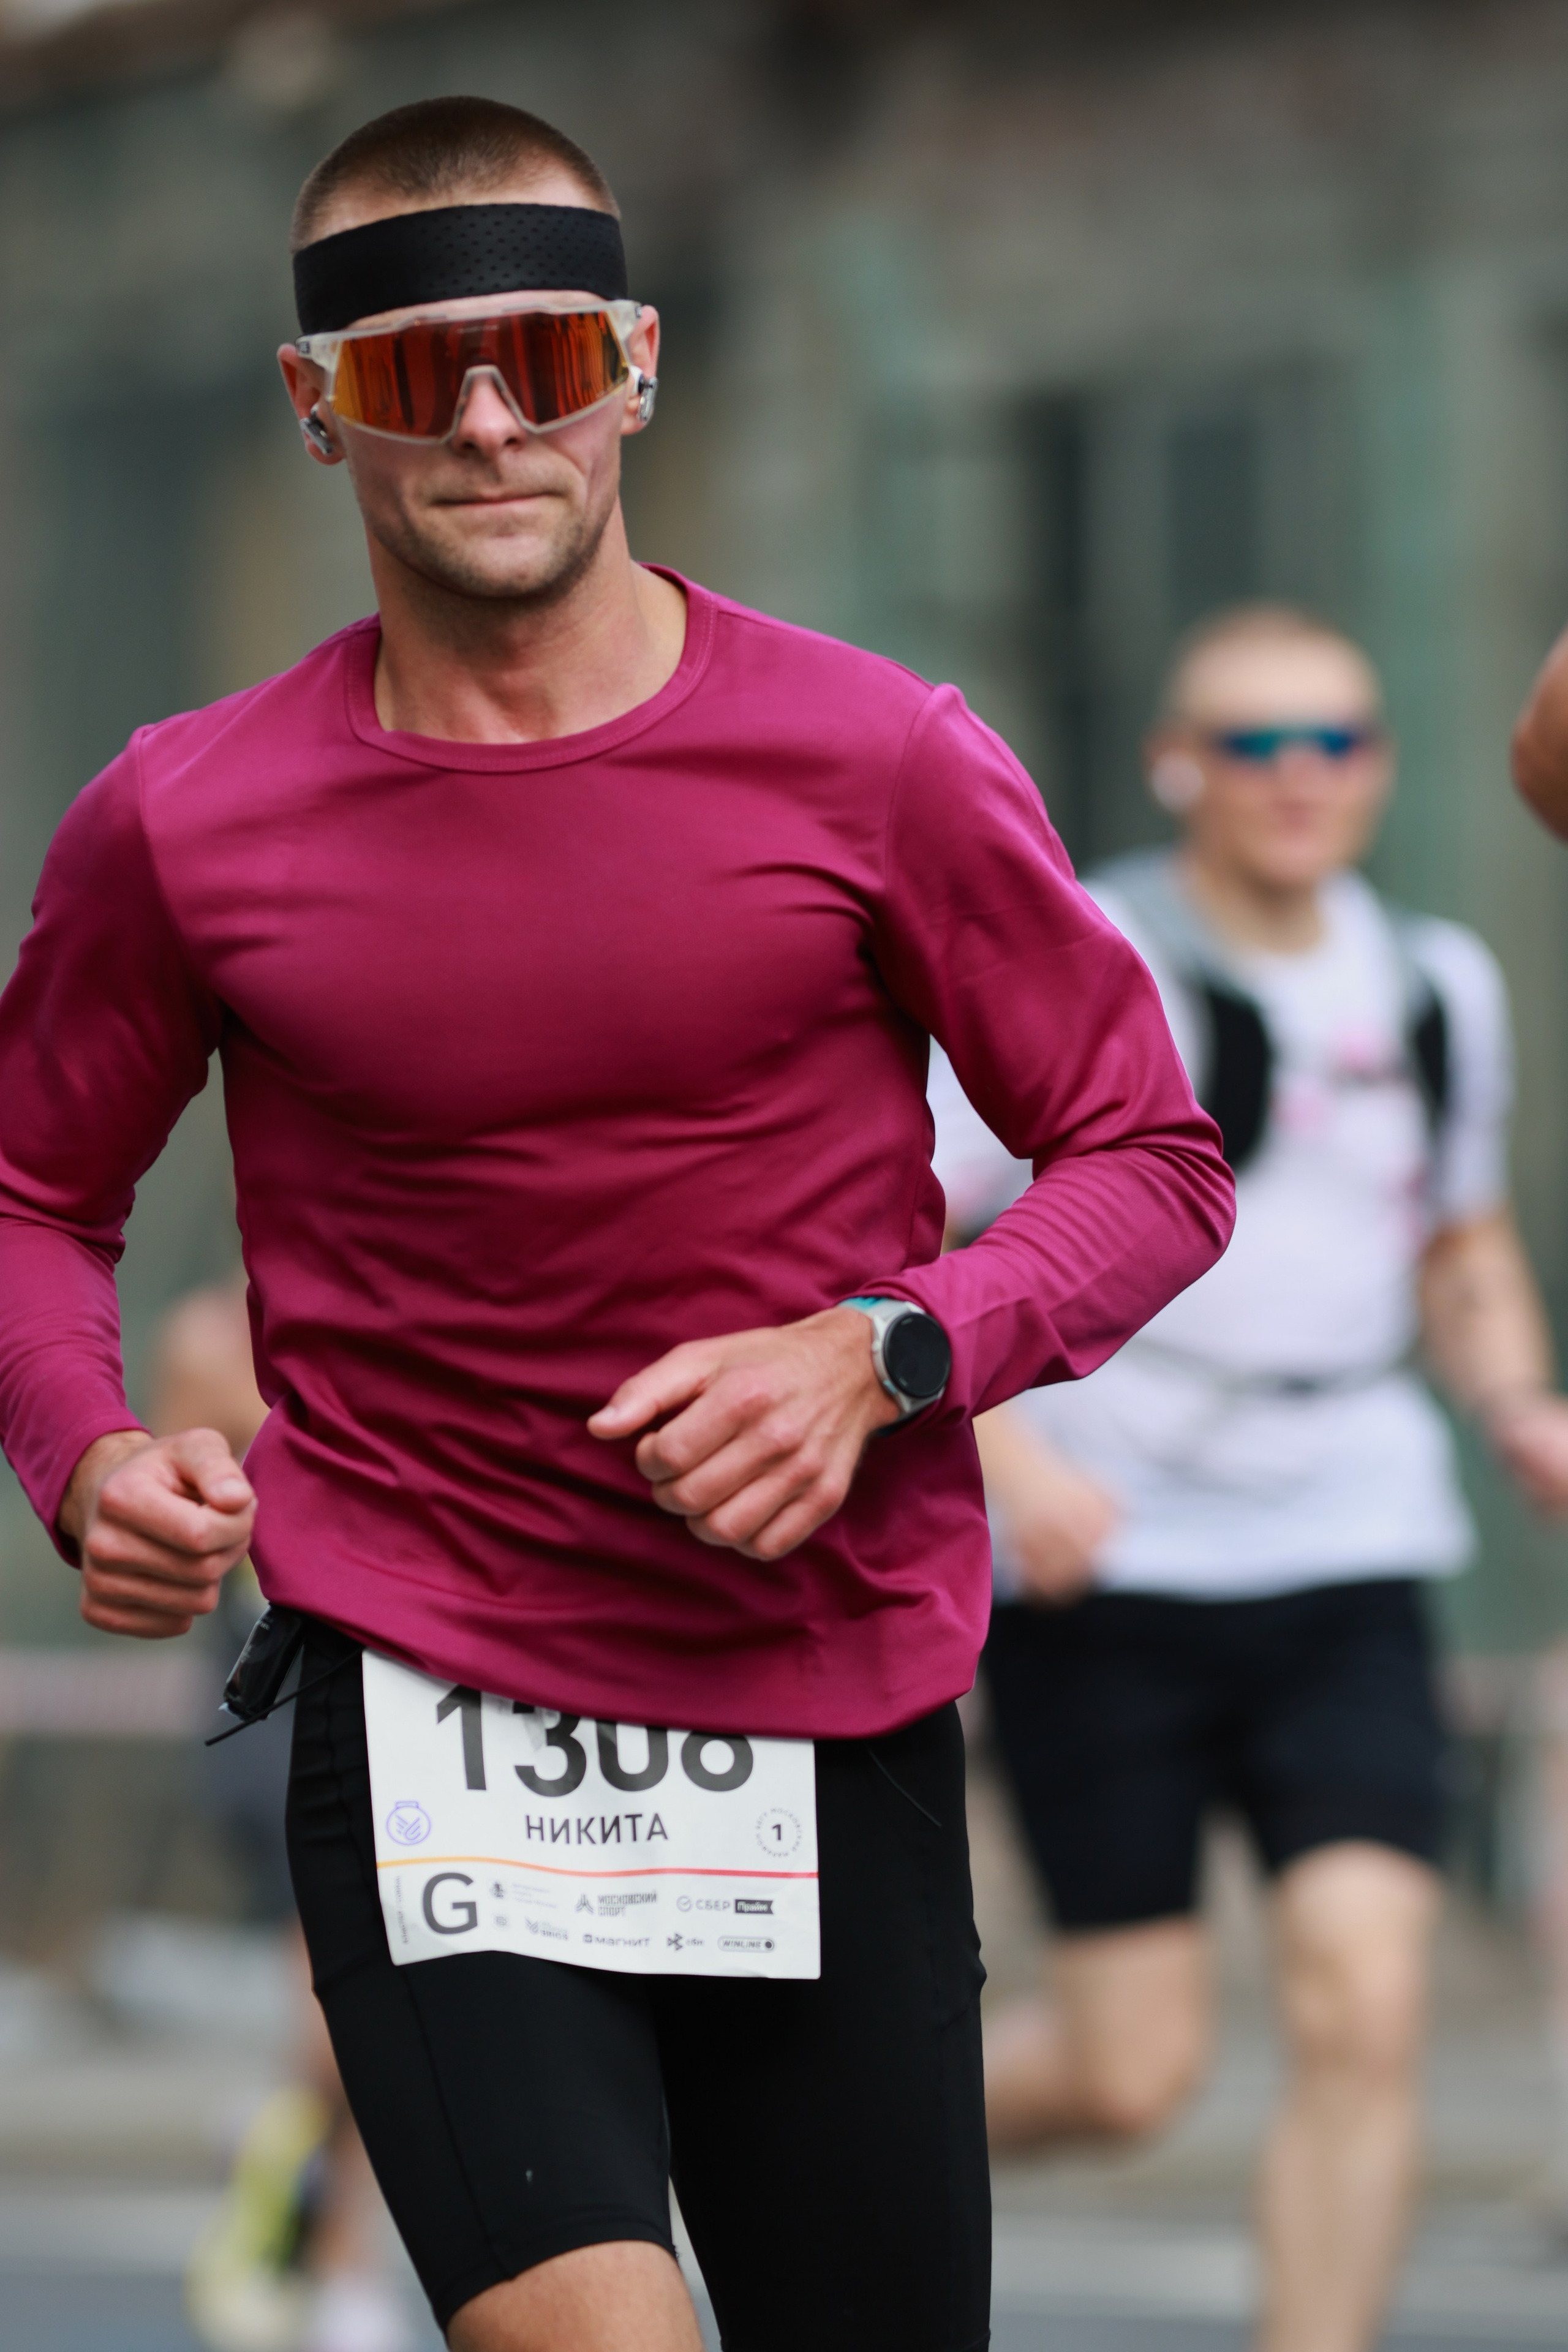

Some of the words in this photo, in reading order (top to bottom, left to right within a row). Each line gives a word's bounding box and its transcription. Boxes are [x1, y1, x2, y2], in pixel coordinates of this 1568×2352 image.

[525, 1813, 669, 1845] НИКИТА
[772, 1824, 782, 1841] 1
[423, 1872, 477, 1934] G
[598, 1891, 657, 1904] МОСКОВСКИЙ
[696, 1899, 729, 1910] СБЕР
[737, 1901, 767, 1912] Прайм
